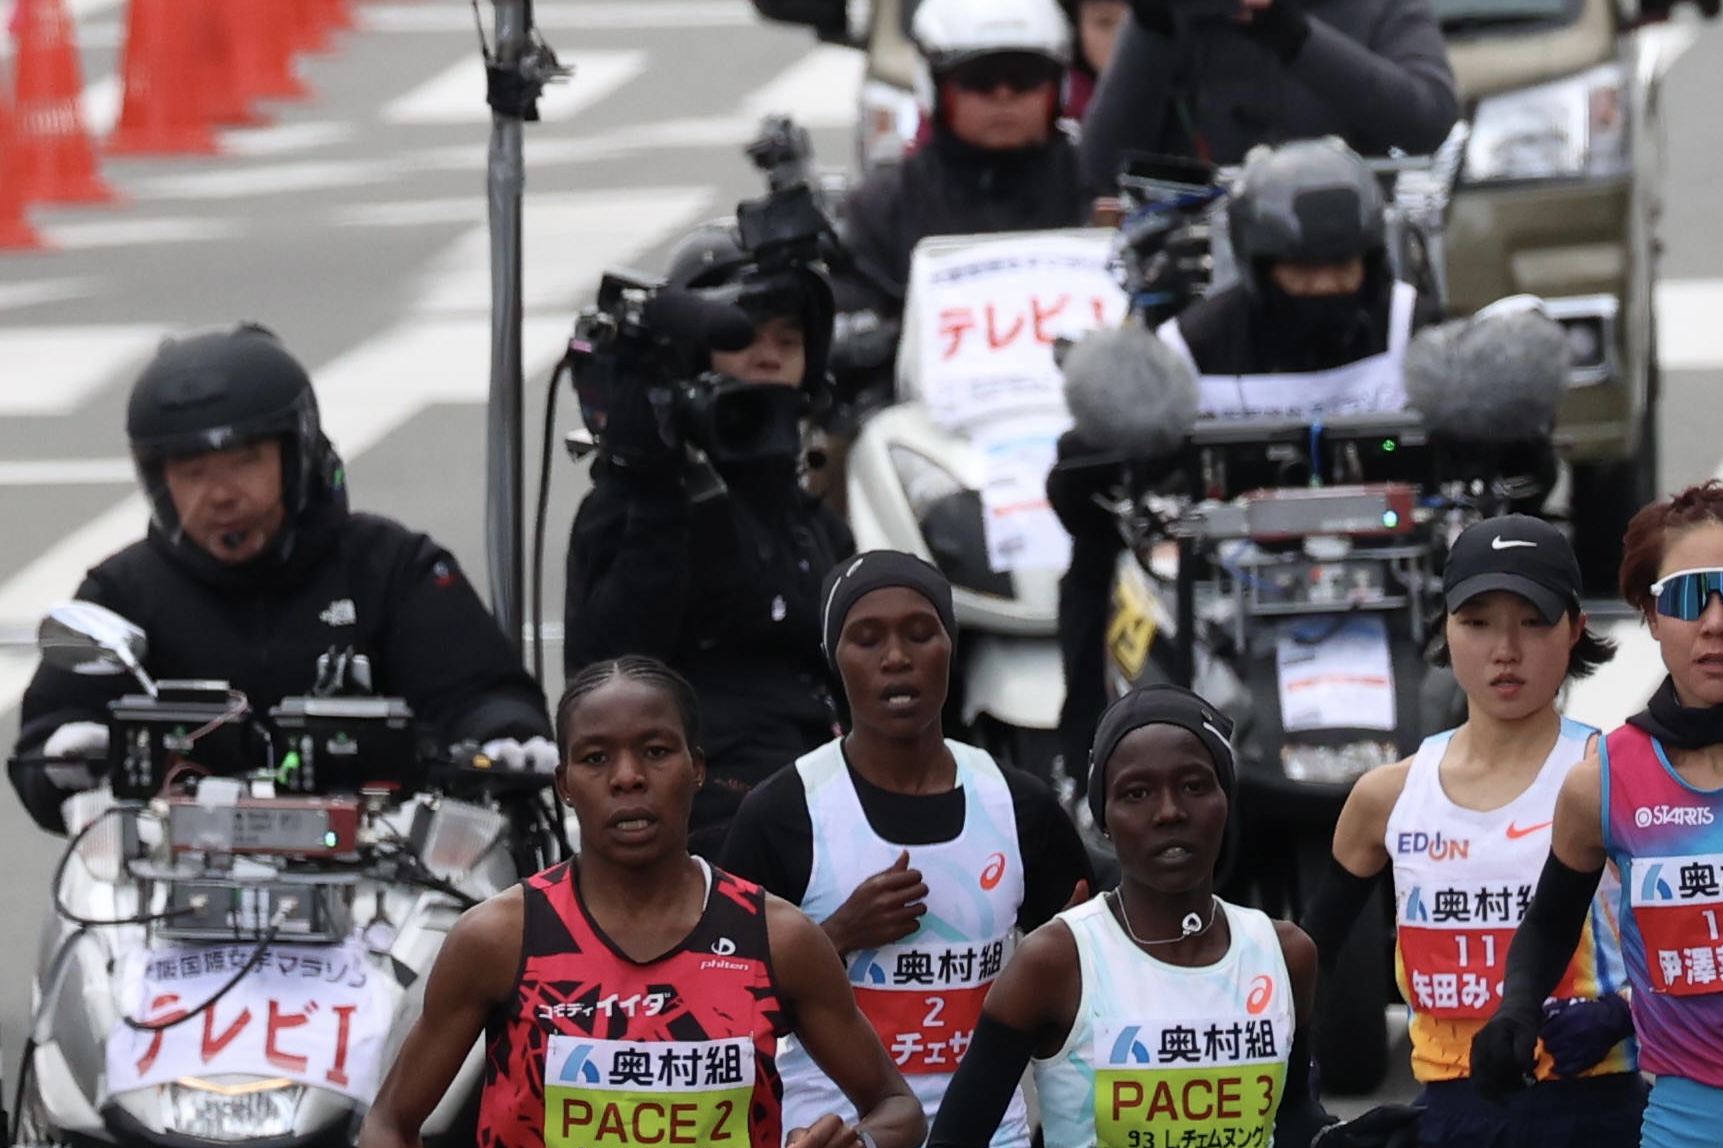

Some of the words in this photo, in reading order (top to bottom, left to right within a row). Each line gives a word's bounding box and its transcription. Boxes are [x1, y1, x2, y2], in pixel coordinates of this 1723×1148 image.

[1398, 832, 1470, 862] EDION
[146, 950, 368, 988] 阪国際女子マラソン
[700, 959, 750, 971] phiten
[892, 940, 1004, 985] 奥村組
[1455, 934, 1495, 968] 11
[538, 992, 671, 1020] コモディイイダ
[922, 996, 945, 1028] 2
[1157, 1020, 1278, 1064] 奥村組
[609, 1044, 743, 1087] 奥村組
[1112, 1077, 1242, 1122] PACE
[1256, 1074, 1274, 1116] 3
[562, 1098, 698, 1145] PACE
[709, 1100, 734, 1142] 2
